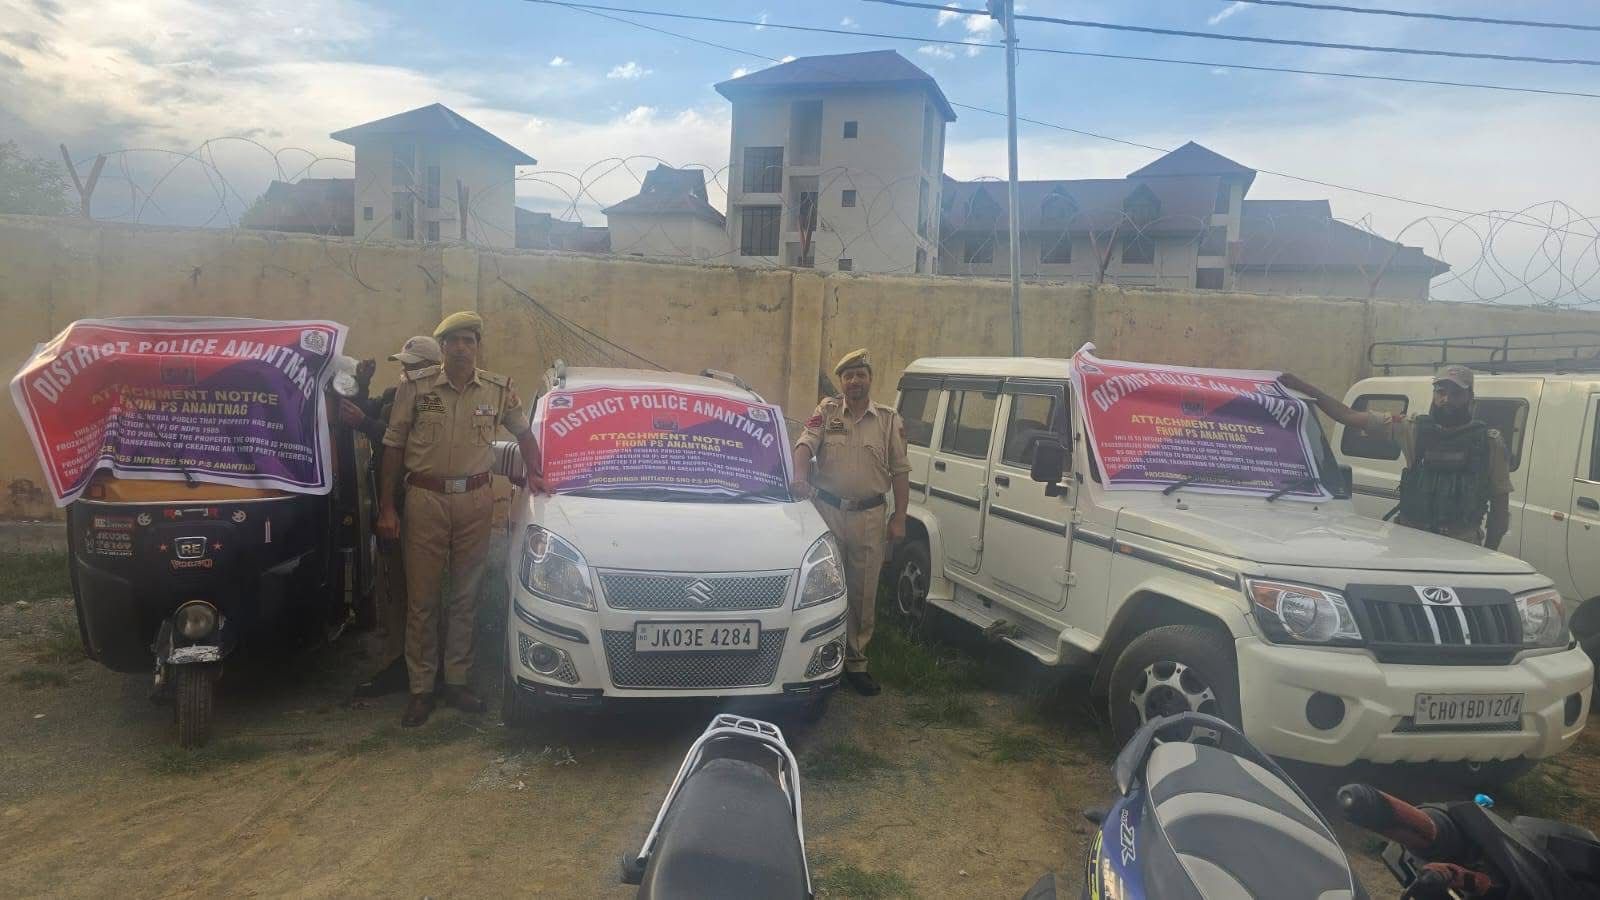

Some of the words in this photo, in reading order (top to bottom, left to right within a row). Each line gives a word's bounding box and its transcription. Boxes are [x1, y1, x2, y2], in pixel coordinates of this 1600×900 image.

[32, 341, 130, 404] DISTRICT
[138, 338, 218, 355] POLICE
[221, 339, 316, 400] ANANTNAG
[91, 383, 208, 404] ATTACHMENT
[215, 390, 279, 405] NOTICE
[1091, 372, 1149, 412] DISTRICT
[1149, 372, 1209, 389] POLICE
[161, 401, 178, 412] PS
[182, 402, 248, 416] ANANTNAG
[171, 415, 198, 424] PUBLIC
[550, 396, 625, 438] DISTRICT
[631, 395, 688, 412] POLICE
[692, 401, 774, 448] ANANTNAG
[1131, 414, 1215, 430] ATTACHMENT
[1218, 422, 1265, 435] NOTICE
[589, 432, 688, 441] ATTACHMENT
[693, 436, 744, 449] NOTICE
[1156, 426, 1184, 437] FROM
[1185, 428, 1199, 439] PS
[1200, 430, 1247, 443] ANANTNAG
[616, 440, 647, 448] FROM
[650, 440, 664, 448] PS
[667, 441, 721, 452] ANANTNAG
[133, 456, 177, 465] INITIATED
[181, 543, 201, 554] RE
[651, 629, 704, 647] JK03E
[711, 628, 752, 646] 4284
[1429, 699, 1521, 721] CH01BD1204
